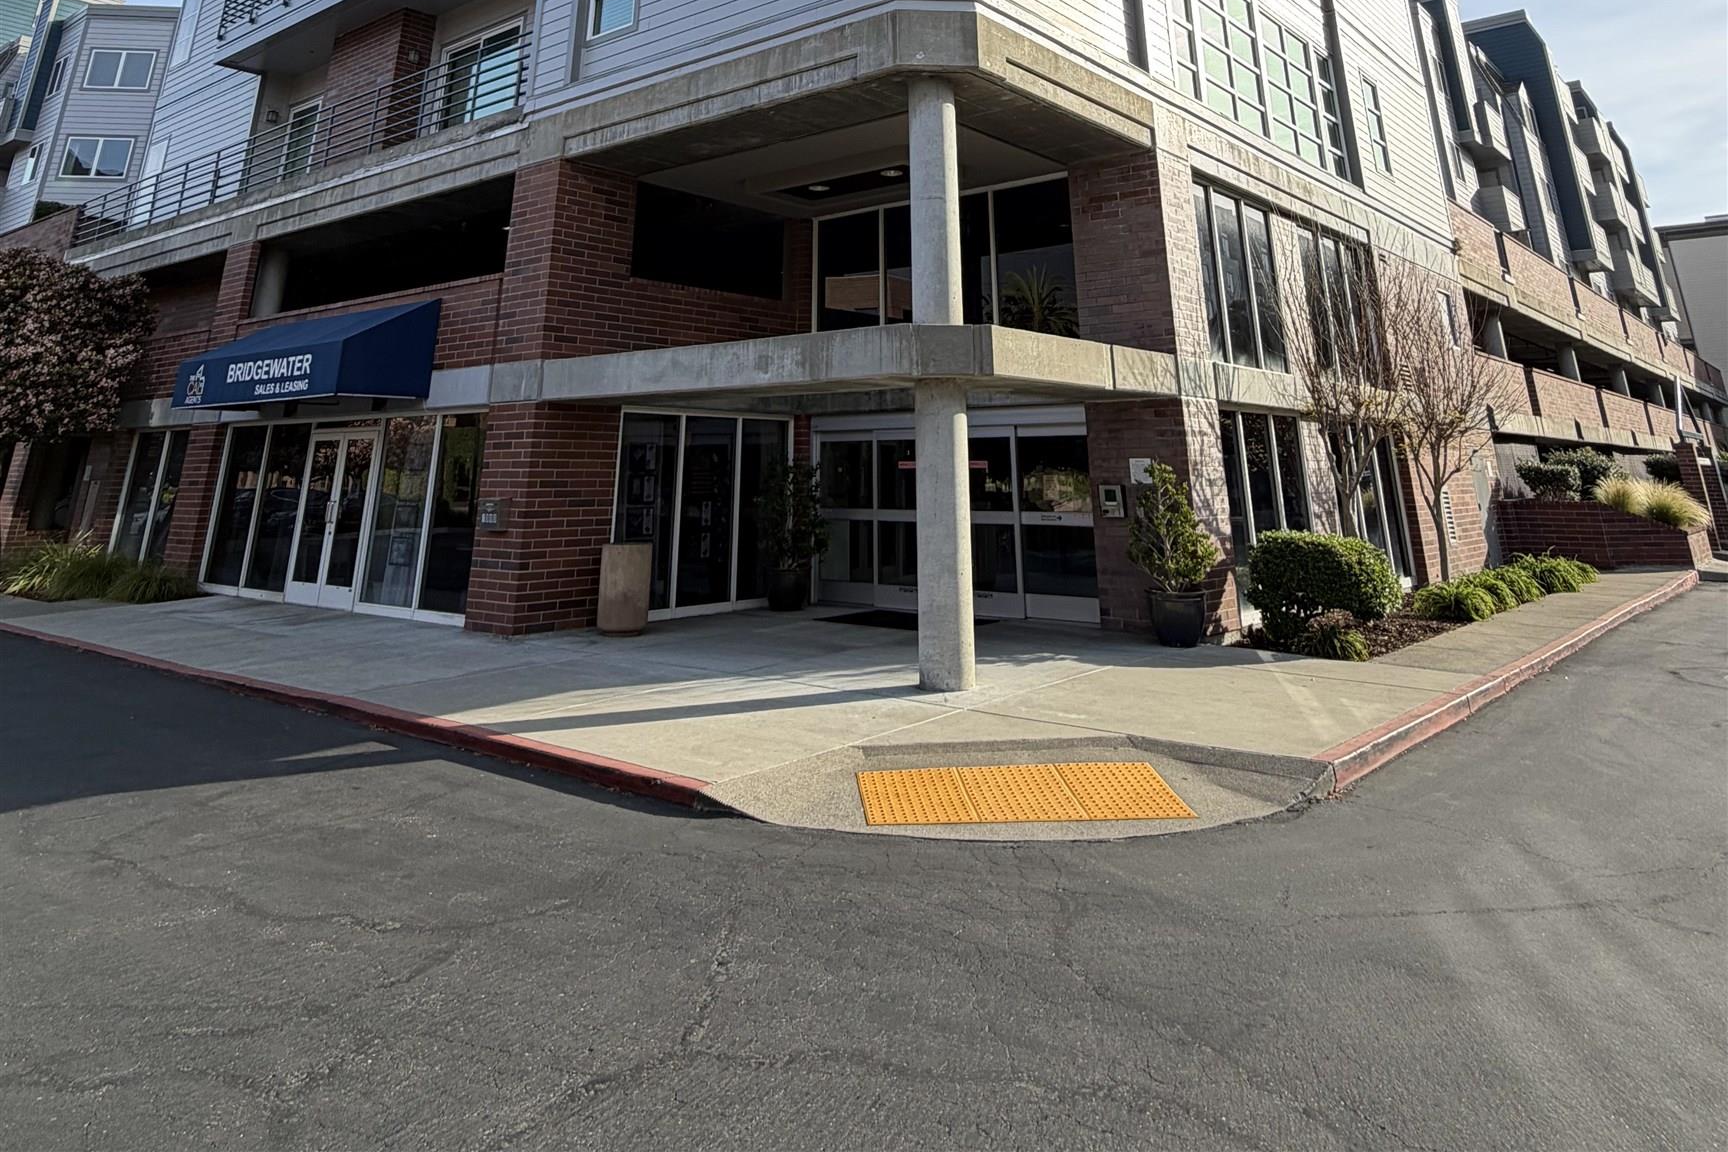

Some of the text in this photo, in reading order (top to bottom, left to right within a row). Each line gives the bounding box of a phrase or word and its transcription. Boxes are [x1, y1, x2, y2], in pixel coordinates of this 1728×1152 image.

[226, 354, 312, 383] BRIDGEWATER
[254, 383, 274, 395] SALES
[281, 379, 309, 393] LEASING
